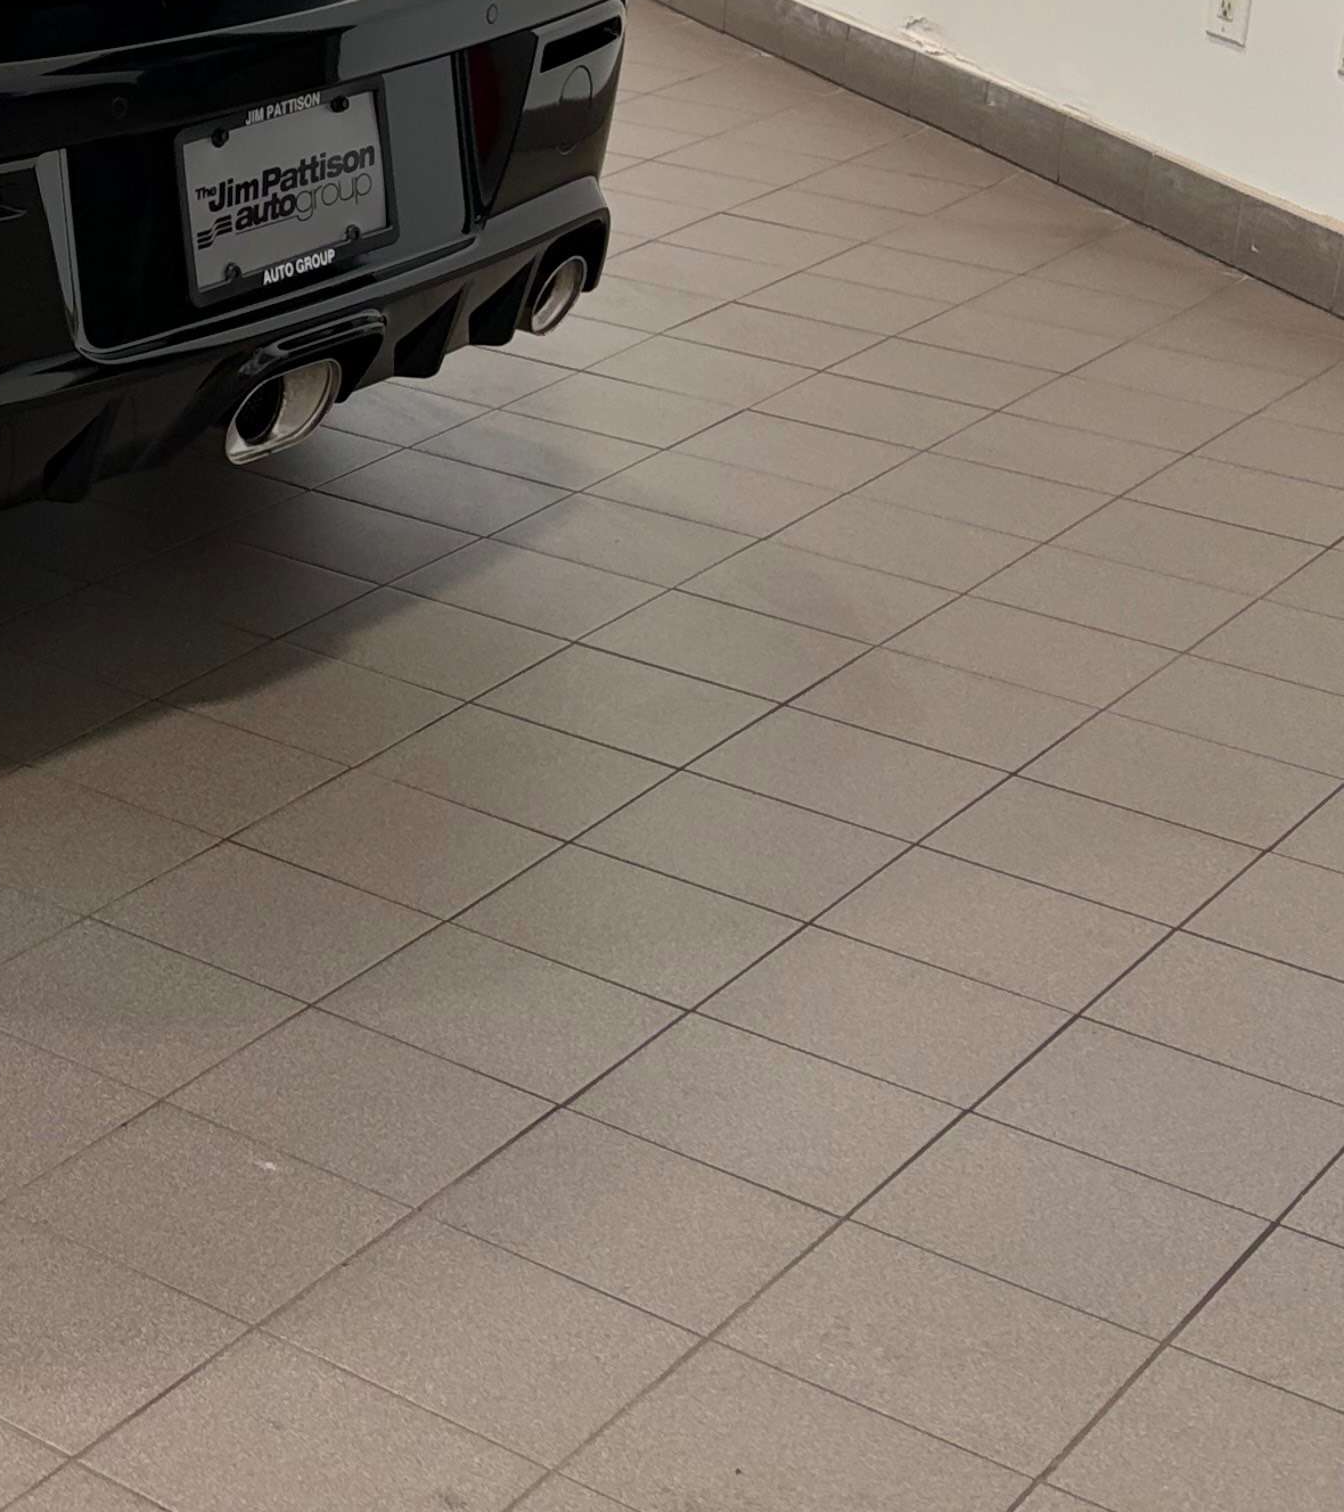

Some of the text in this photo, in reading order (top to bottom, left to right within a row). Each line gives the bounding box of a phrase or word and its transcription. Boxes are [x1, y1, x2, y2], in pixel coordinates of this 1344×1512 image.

[246, 91, 320, 126] JIM PATTISON
[209, 177, 260, 212] Jim
[261, 144, 375, 198] Pattison
[263, 248, 336, 286] AUTO GROUP
